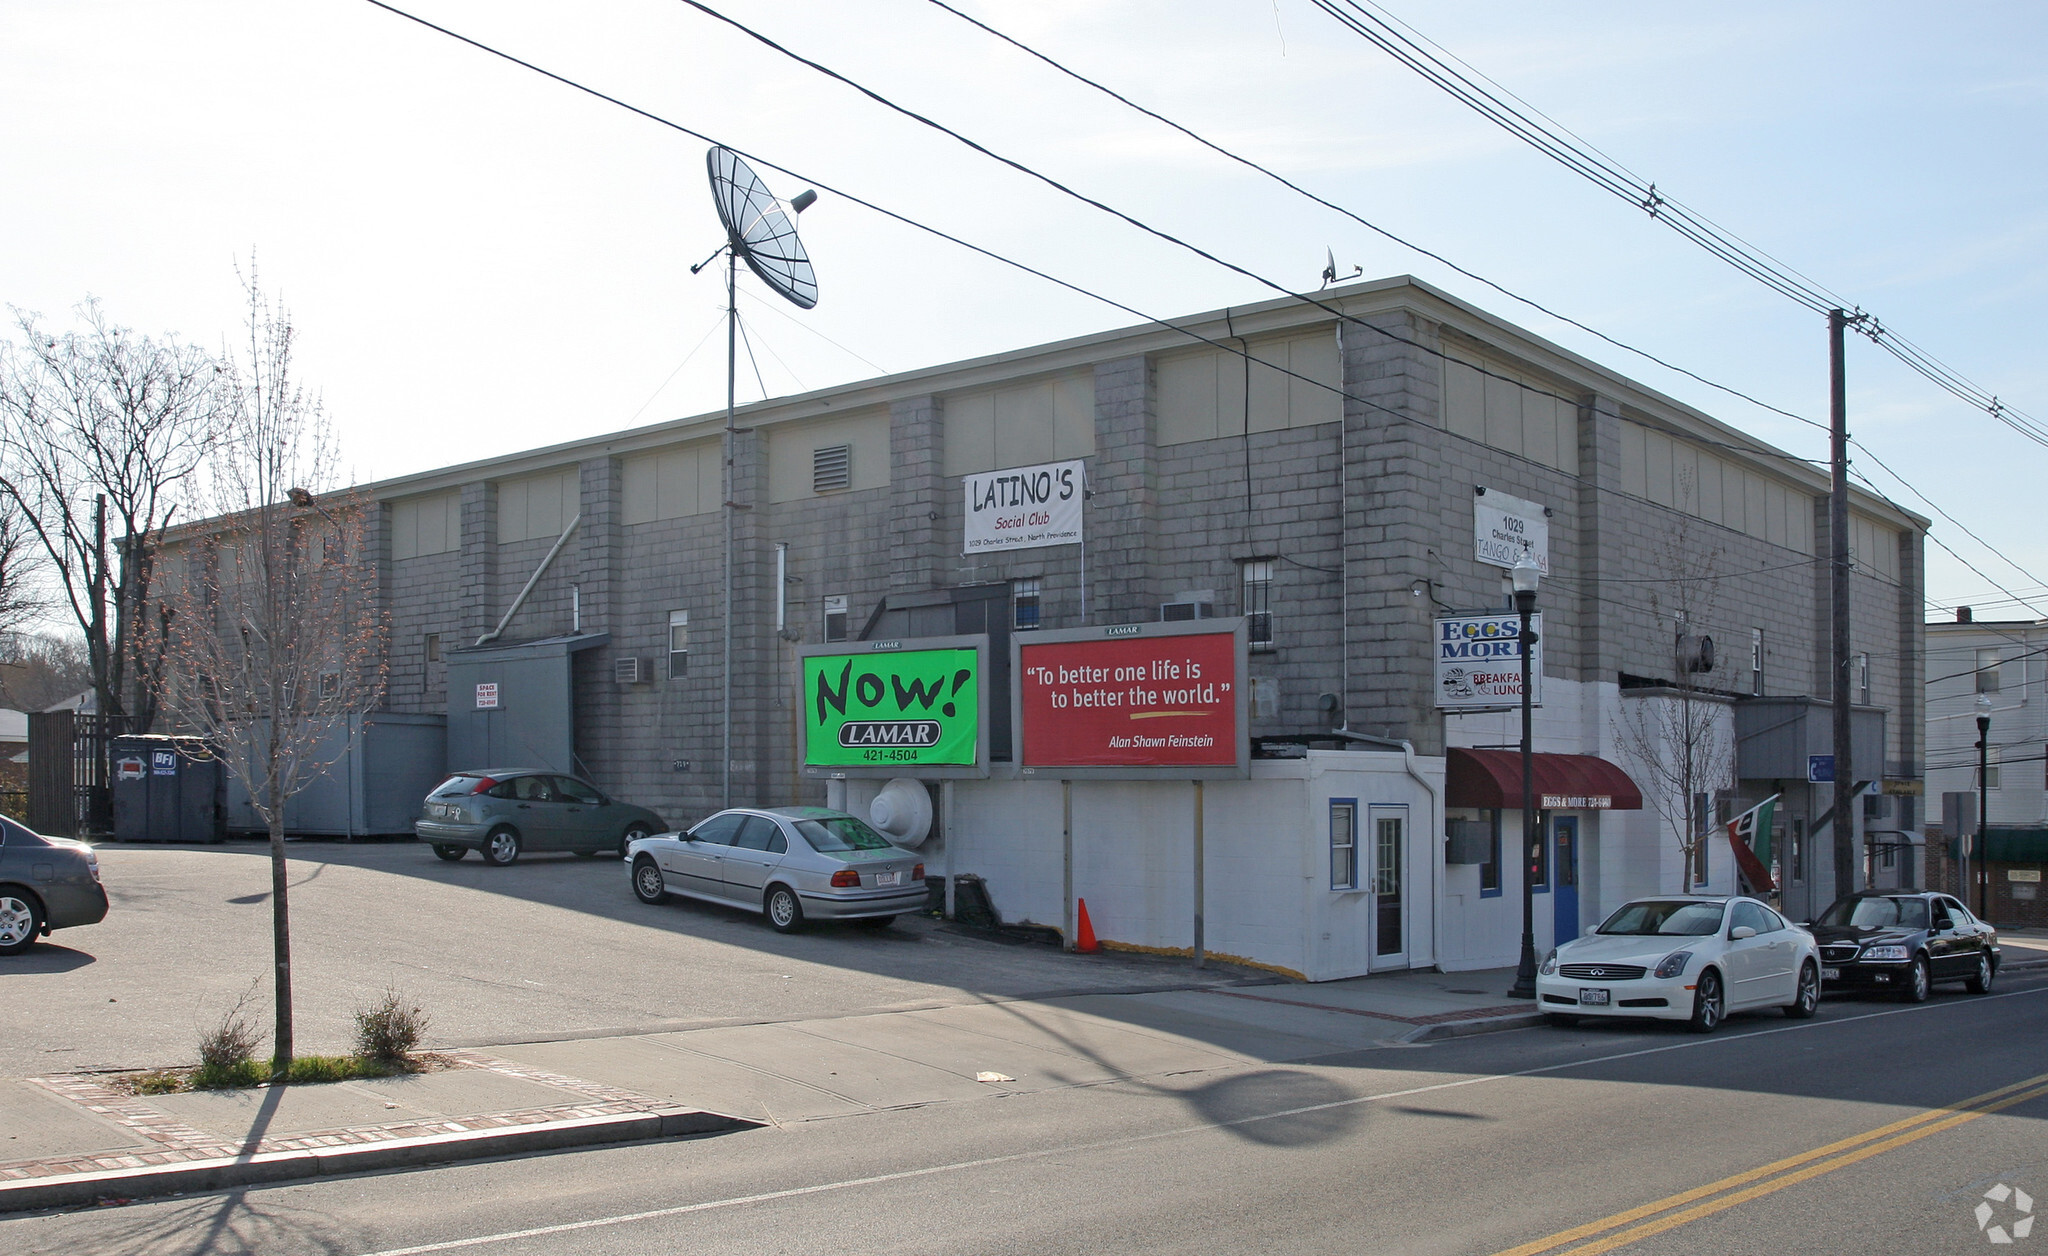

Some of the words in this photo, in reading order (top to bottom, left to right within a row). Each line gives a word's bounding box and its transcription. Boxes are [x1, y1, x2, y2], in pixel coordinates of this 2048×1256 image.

[973, 468, 1074, 512] LATINO'S
[995, 514, 1025, 530] Social
[1028, 511, 1050, 526] Club
[1503, 516, 1524, 533] 1029
[969, 540, 981, 548] 1029
[983, 538, 1003, 546] Charles
[1046, 530, 1077, 539] Providence
[1492, 528, 1515, 543] Charles
[1478, 538, 1510, 561] TANGO
[1109, 626, 1138, 635] LAMAR
[1441, 620, 1518, 640] EGGS
[875, 641, 899, 649] LAMAR
[1059, 665, 1110, 684] better
[1114, 666, 1146, 681] one
[1152, 659, 1180, 680] life
[1186, 659, 1201, 679] is
[1473, 672, 1533, 684] BREAKFA
[1051, 690, 1068, 708] to
[1073, 688, 1124, 708] better
[1129, 685, 1157, 706] the
[848, 725, 930, 743] LAMAR
[1109, 736, 1131, 748] Alan
[1133, 735, 1166, 748] Shawn
[1168, 734, 1214, 747] Feinstein
[155, 752, 173, 766] BFI
[863, 750, 918, 761] 421-4504
[1543, 796, 1561, 807] EGGS
[1561, 797, 1567, 807] &
[1567, 796, 1587, 807] MORE
